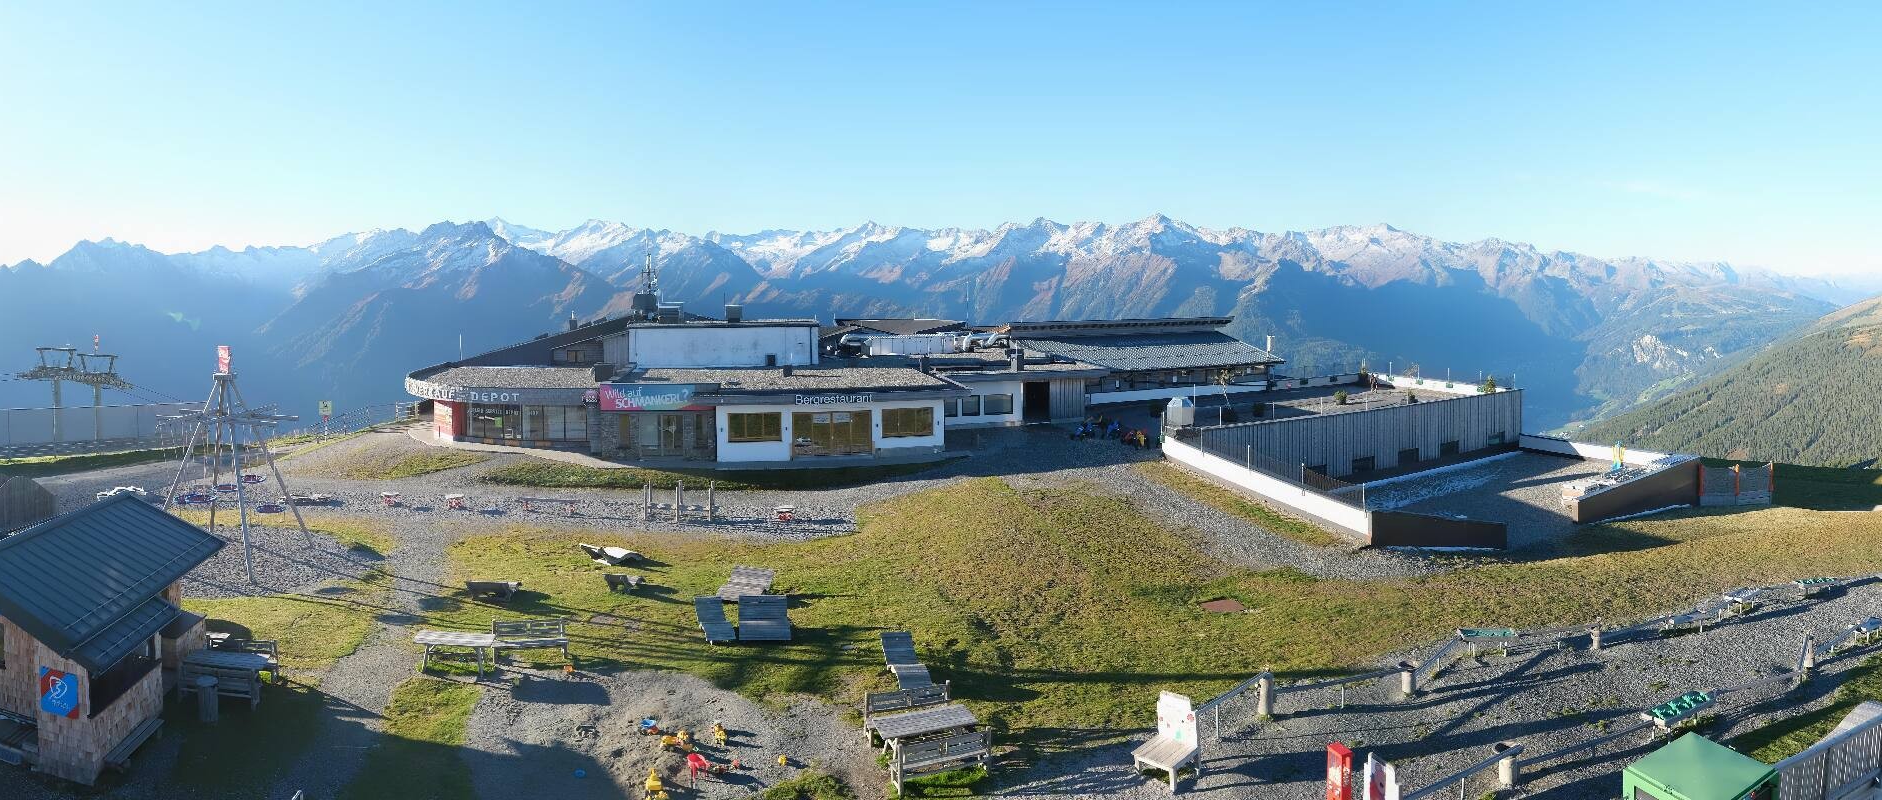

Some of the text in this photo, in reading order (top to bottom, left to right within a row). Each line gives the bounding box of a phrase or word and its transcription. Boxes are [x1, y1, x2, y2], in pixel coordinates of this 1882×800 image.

[470, 391, 520, 402] DEPOT
[605, 386, 643, 400] Wild auf
[615, 388, 689, 409] SCHMANKERL?
[795, 393, 873, 405] Bergrestaurant
